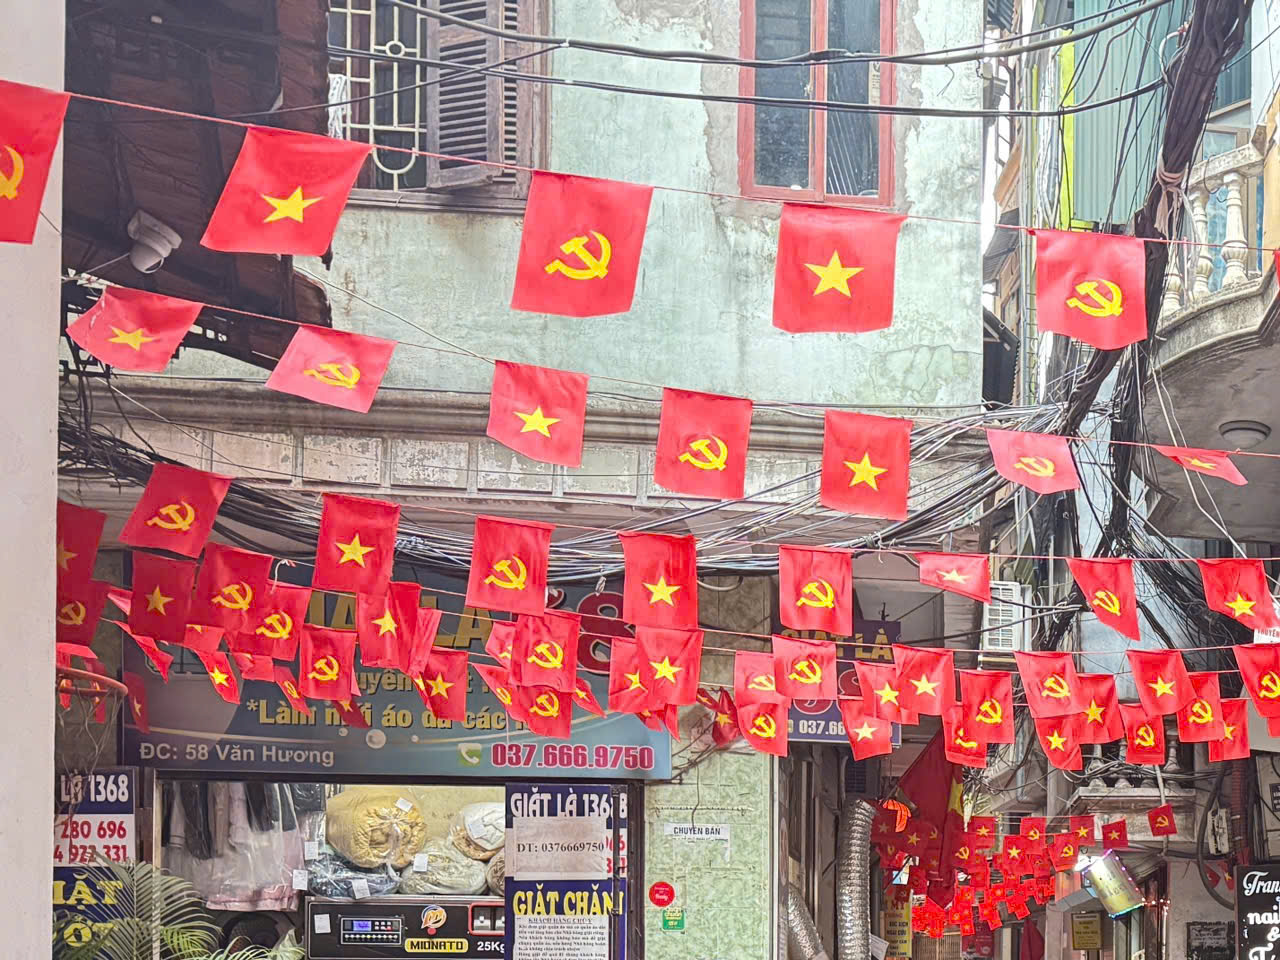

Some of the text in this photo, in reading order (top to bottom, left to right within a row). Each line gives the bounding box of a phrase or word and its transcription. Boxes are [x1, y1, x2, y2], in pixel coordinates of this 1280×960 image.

[381, 703, 414, 729] áo
[140, 741, 335, 767] ĐC: 58 Văn Hương
[491, 743, 654, 770] 037.666.9750
[88, 773, 130, 802] 1368
[97, 821, 128, 839] 696
[541, 842, 605, 853] 0376669750
